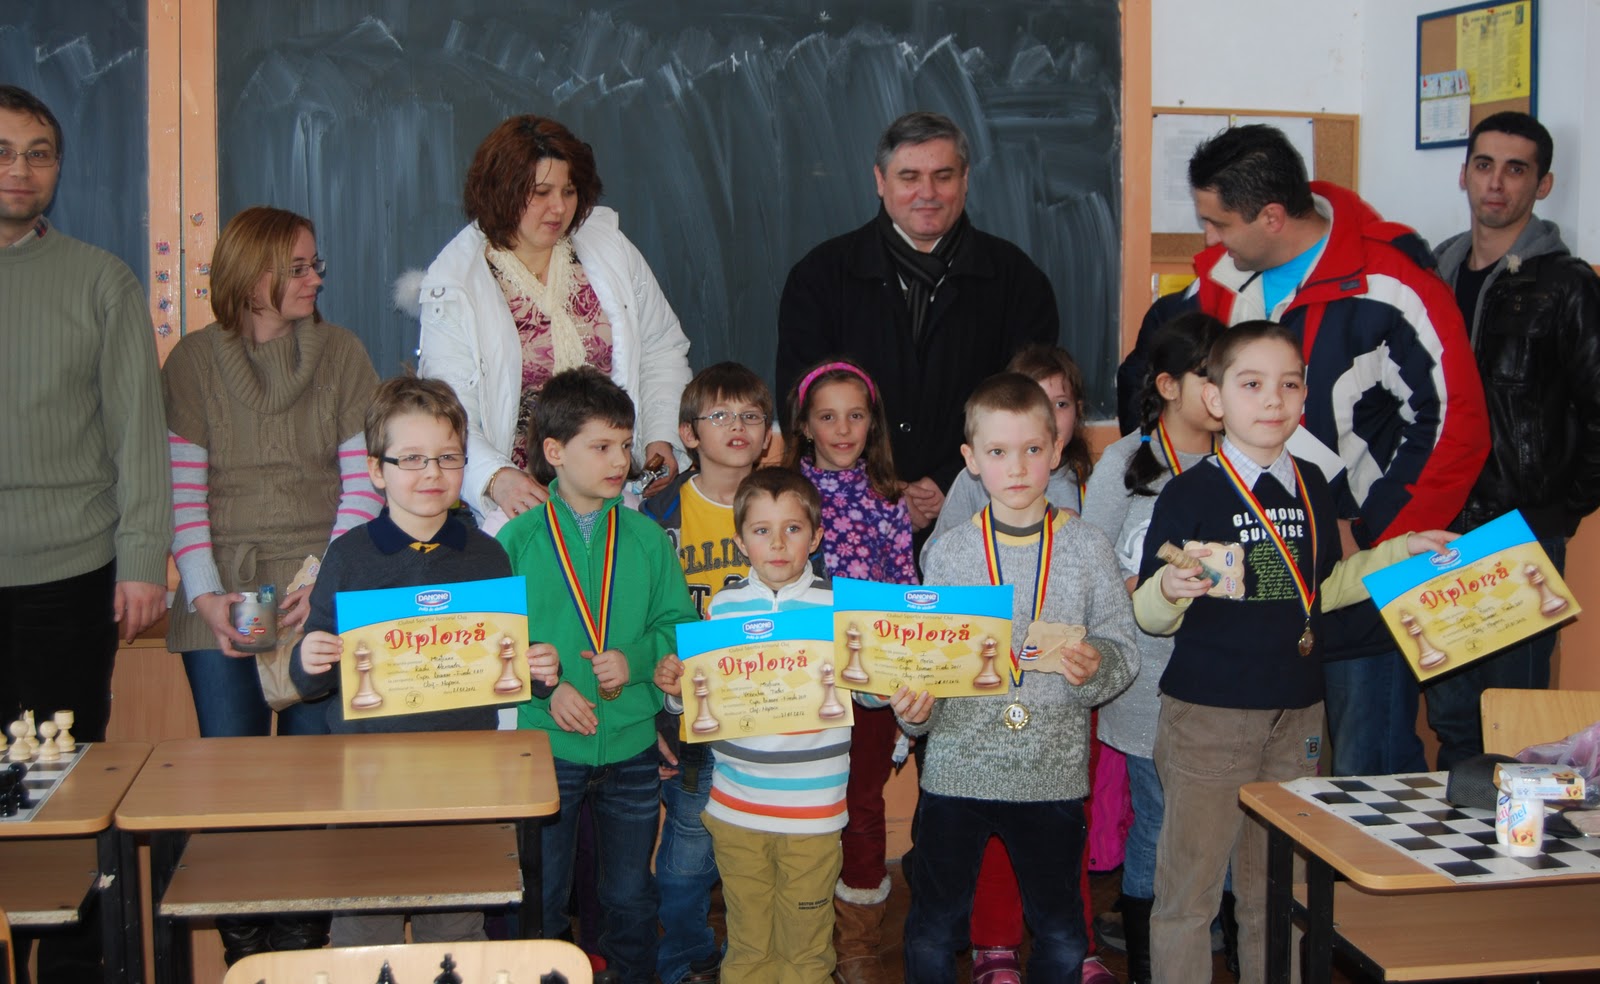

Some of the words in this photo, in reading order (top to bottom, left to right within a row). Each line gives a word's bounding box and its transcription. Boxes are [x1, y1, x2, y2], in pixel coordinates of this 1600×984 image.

[1232, 508, 1304, 527] GLMOUR
[1240, 524, 1304, 542] SURISE
[1432, 550, 1458, 564] DANNE
[1420, 562, 1509, 608] Diplomă
[418, 592, 448, 602] DANONE
[745, 622, 772, 630] DANONE
[873, 619, 970, 646] Diplomă
[384, 622, 486, 654] Diplomă
[718, 649, 808, 680] Diplomă
[1310, 742, 1318, 753] B
